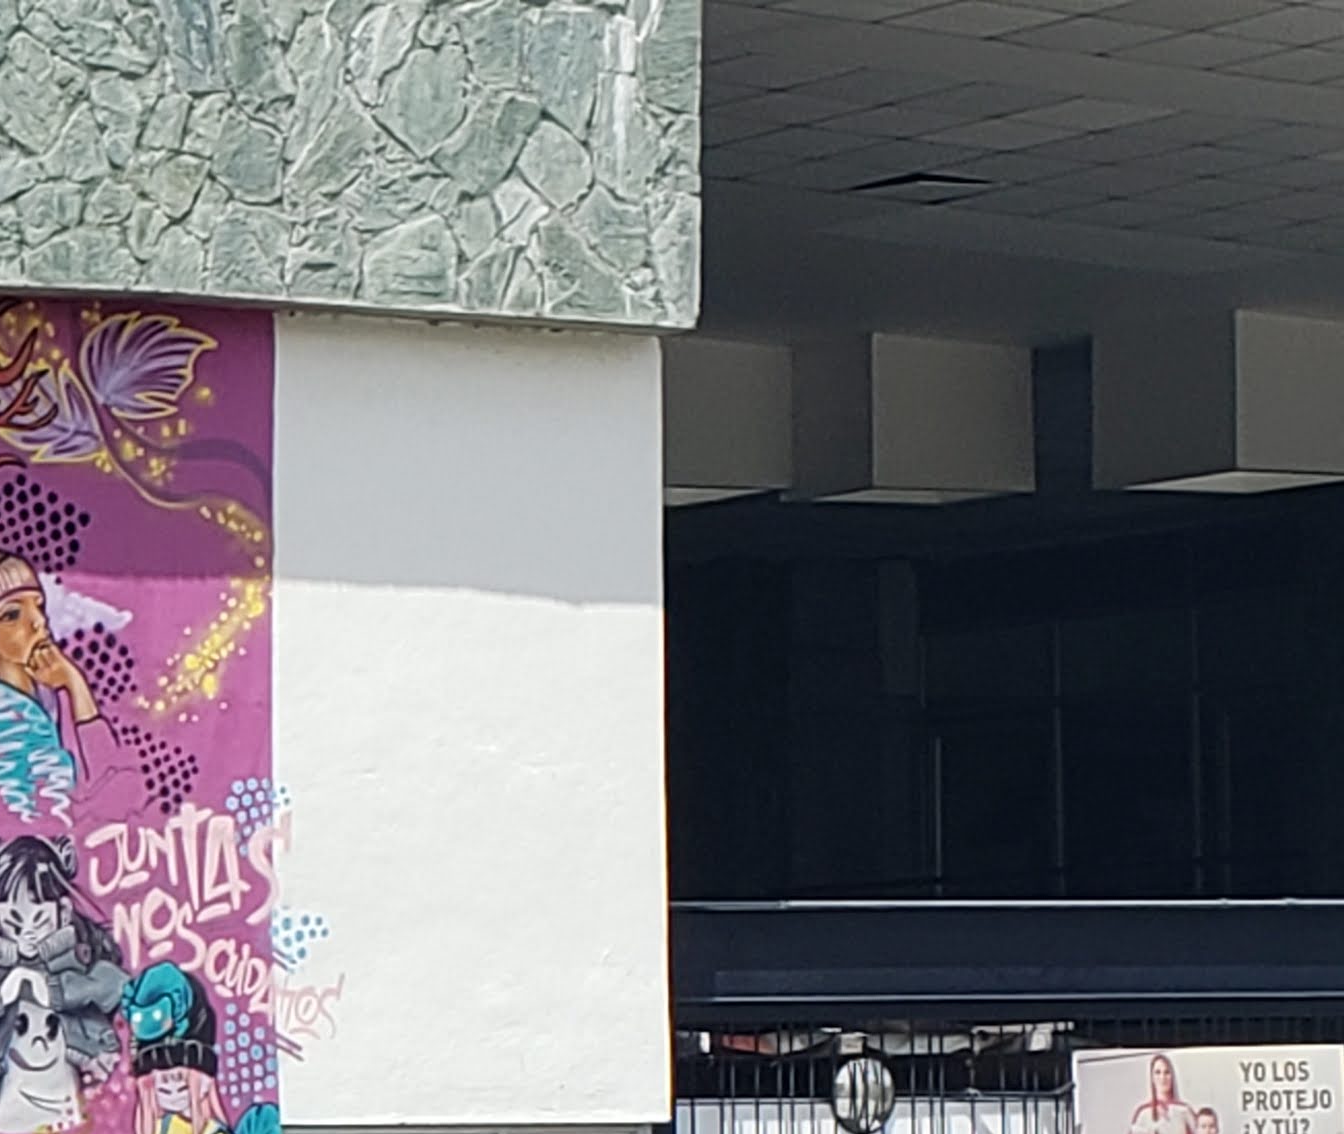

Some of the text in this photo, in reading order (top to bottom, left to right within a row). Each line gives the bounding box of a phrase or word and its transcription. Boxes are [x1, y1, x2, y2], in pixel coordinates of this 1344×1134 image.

[85, 803, 293, 925] JUNTAS
[112, 887, 207, 976] NOS
[1239, 1060, 1311, 1084] YO LOS
[1241, 1088, 1333, 1112] PROTEJO
